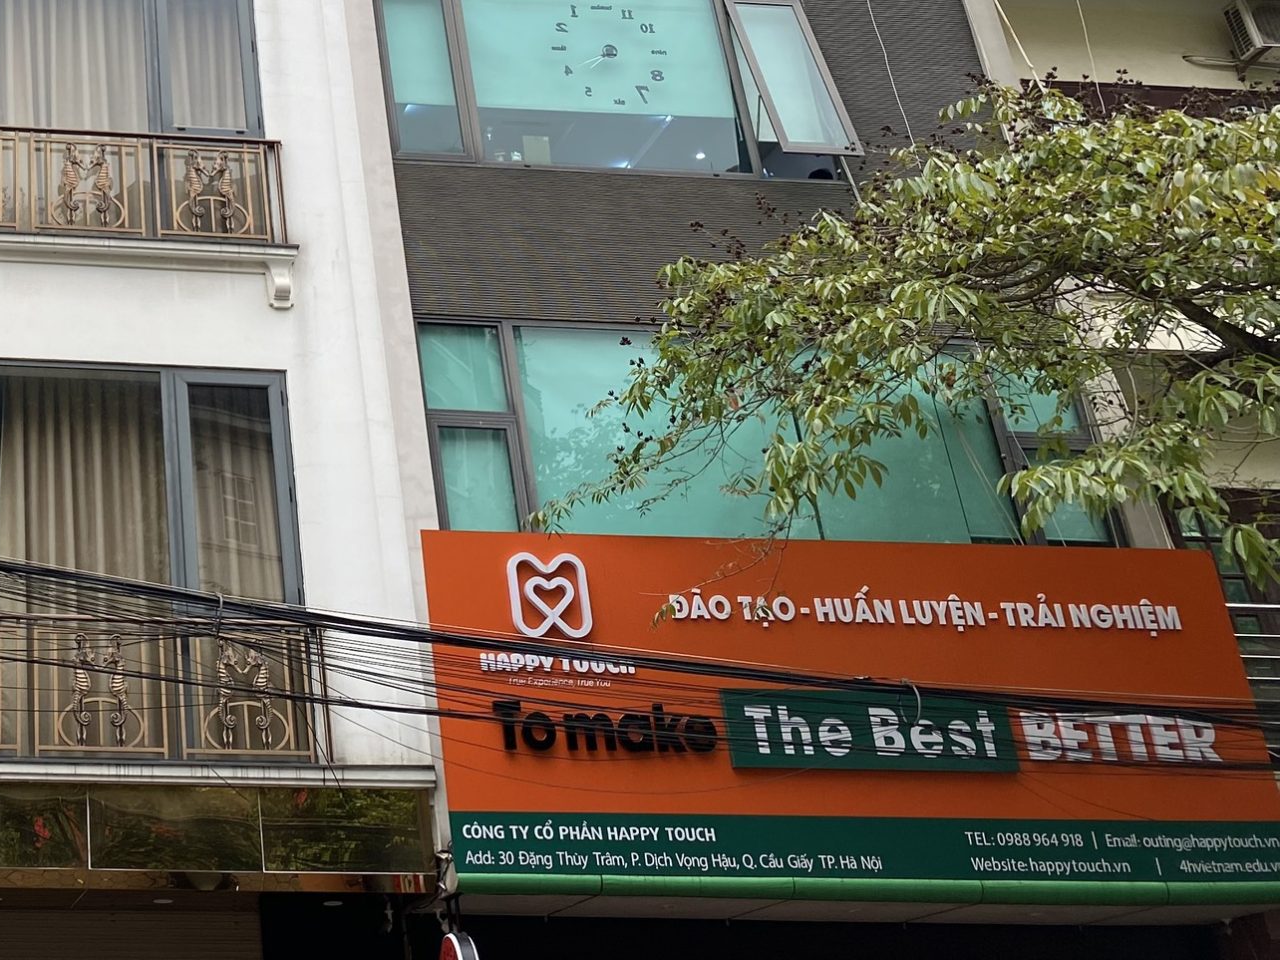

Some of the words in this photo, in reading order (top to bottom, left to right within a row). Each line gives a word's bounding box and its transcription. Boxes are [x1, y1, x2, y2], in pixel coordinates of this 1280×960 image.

[668, 588, 732, 620] ĐÀO
[737, 594, 796, 627] TẠO
[814, 586, 895, 624] HUẤN
[899, 594, 986, 632] LUYỆN
[1000, 593, 1066, 628] TRẢI
[1068, 599, 1182, 636] NGHIỆM
[480, 653, 554, 672] HAPPY
[744, 704, 852, 757] The
[868, 707, 998, 759] Best
[1020, 711, 1223, 762] BETTER
[462, 821, 505, 840] CÔNG
[509, 825, 528, 840] TY
[534, 819, 555, 840] CỔ
[559, 819, 602, 840] PHẦN
[607, 826, 659, 841] HAPPY
[665, 827, 716, 842] TOUCH
[997, 832, 1031, 847] 0988
[1032, 833, 1059, 848] 964
[1060, 833, 1084, 848] 918
[466, 851, 495, 865] Add:
[498, 851, 514, 866] 30
[518, 850, 553, 869] Đặng
[556, 851, 589, 869] Thùy
[593, 851, 628, 869] Trâm,
[632, 854, 642, 867] P.
[645, 852, 673, 870] Dịch
[675, 854, 709, 872] Vọng
[712, 853, 740, 871] Hậu,
[742, 855, 758, 871] Q.
[760, 851, 784, 869] Cầu
[787, 852, 814, 872] Giấy
[818, 855, 838, 870] TP.
[840, 855, 858, 870] Hà
[860, 855, 883, 873] Nội
